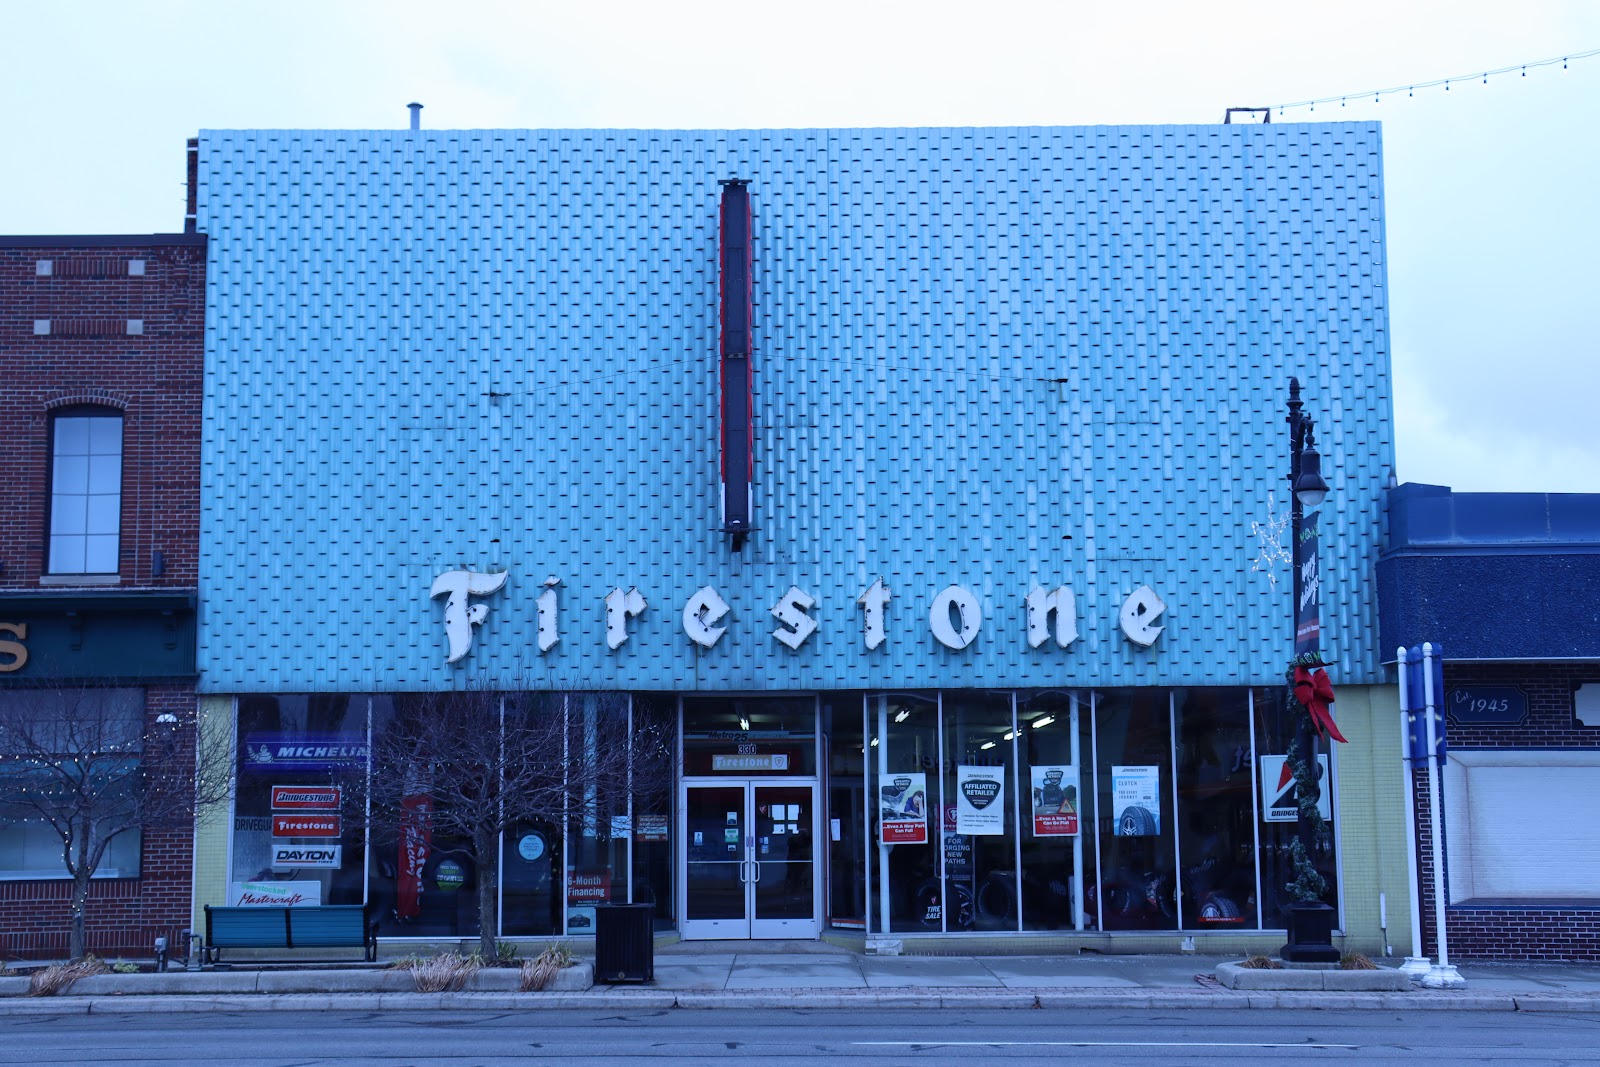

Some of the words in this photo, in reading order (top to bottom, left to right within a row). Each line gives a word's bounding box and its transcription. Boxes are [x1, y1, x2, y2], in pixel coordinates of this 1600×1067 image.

[430, 569, 1168, 664] Firestone
[1470, 699, 1508, 712] 1945
[276, 747, 369, 757] MICHELIN
[737, 744, 757, 755] 330
[715, 756, 770, 768] Firestone
[277, 792, 335, 802] BRIDGESTONE
[278, 821, 334, 831] Firestone
[276, 850, 335, 860] DAYTON
[568, 875, 602, 886] 6-Month
[241, 883, 287, 895] overstocked
[568, 886, 605, 898] Financing
[237, 893, 316, 907] Mastercraft
[927, 905, 941, 913] TIRE
